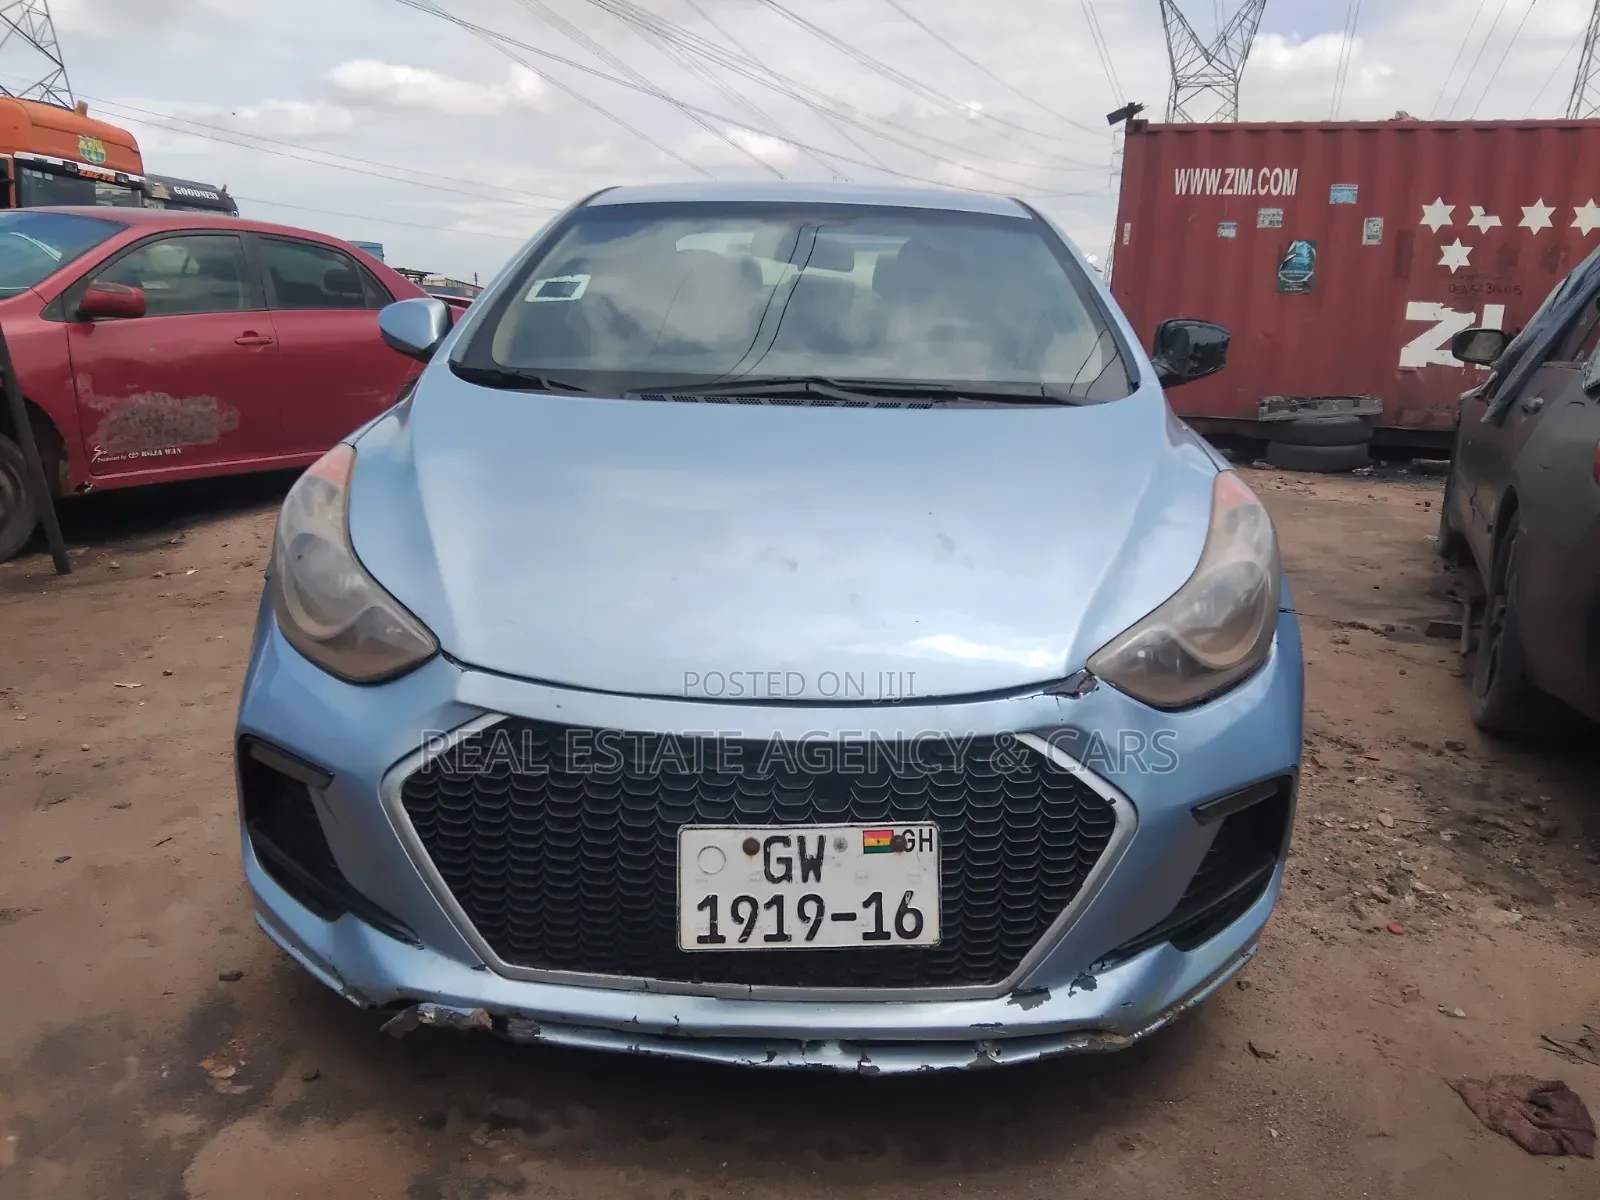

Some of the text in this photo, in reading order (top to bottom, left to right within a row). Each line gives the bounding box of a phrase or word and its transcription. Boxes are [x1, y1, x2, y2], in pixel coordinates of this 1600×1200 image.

[173, 186, 220, 200] GOODNESS
[1174, 167, 1299, 196] WWW.ZIM.COM
[763, 828, 933, 884] GW GH
[696, 889, 924, 944] 1919-16
